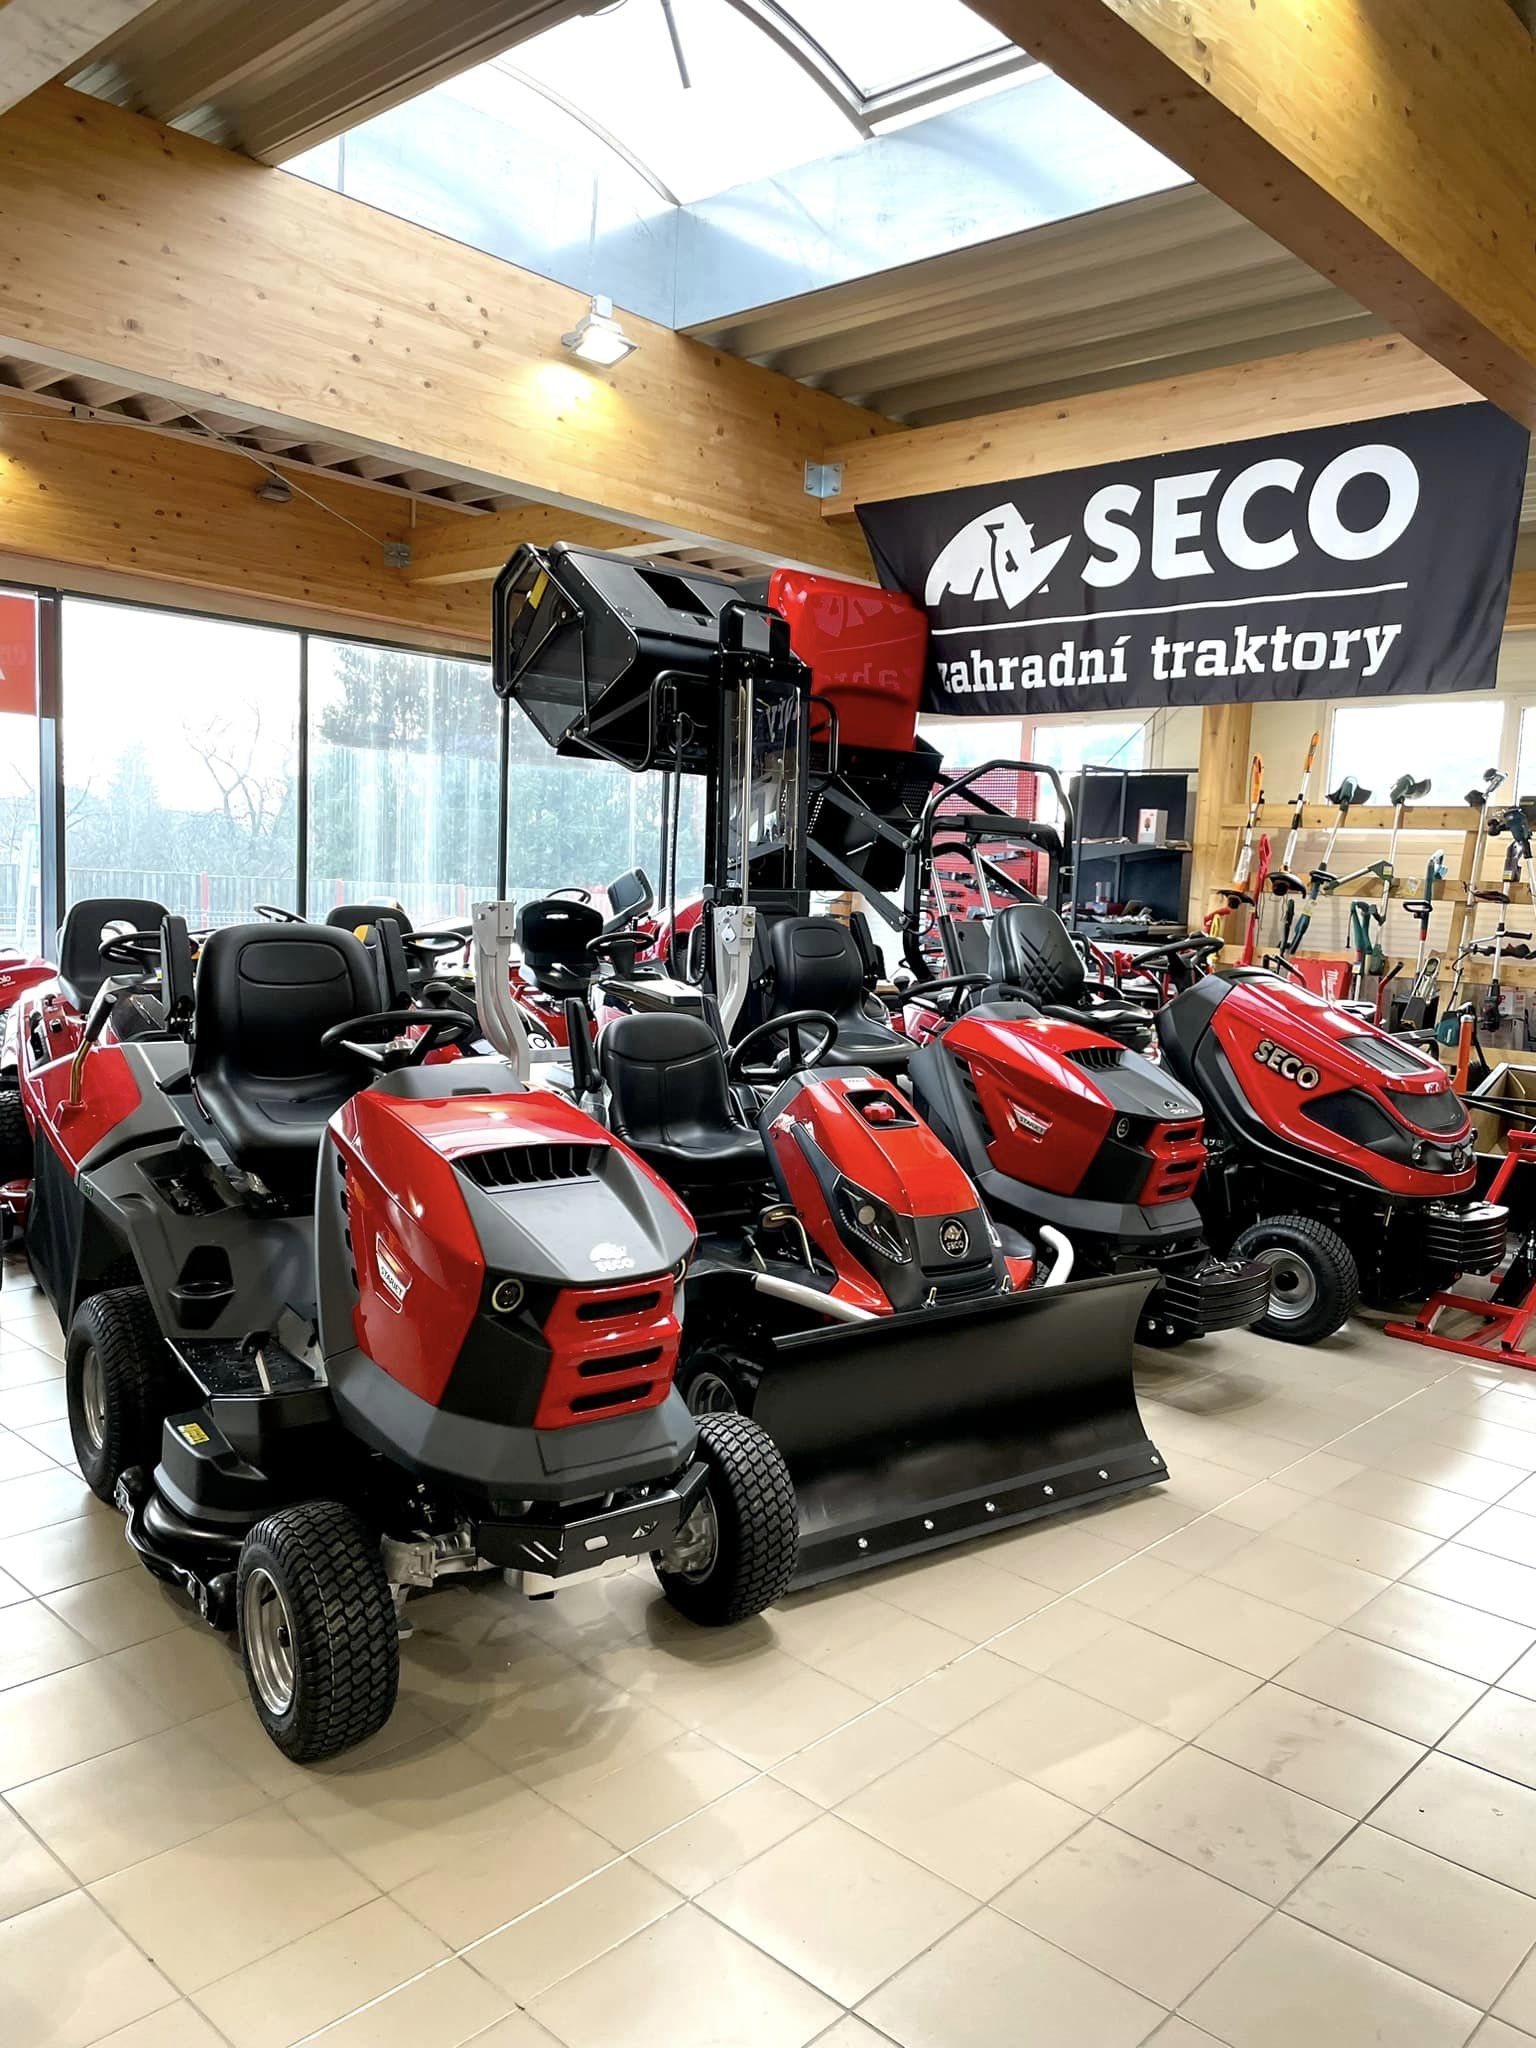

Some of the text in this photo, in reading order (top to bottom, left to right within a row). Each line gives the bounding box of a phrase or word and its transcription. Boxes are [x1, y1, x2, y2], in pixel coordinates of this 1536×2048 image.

[1080, 443, 1421, 588] SECO
[1151, 623, 1402, 682] traktory
[1253, 1040, 1320, 1089] SECO
